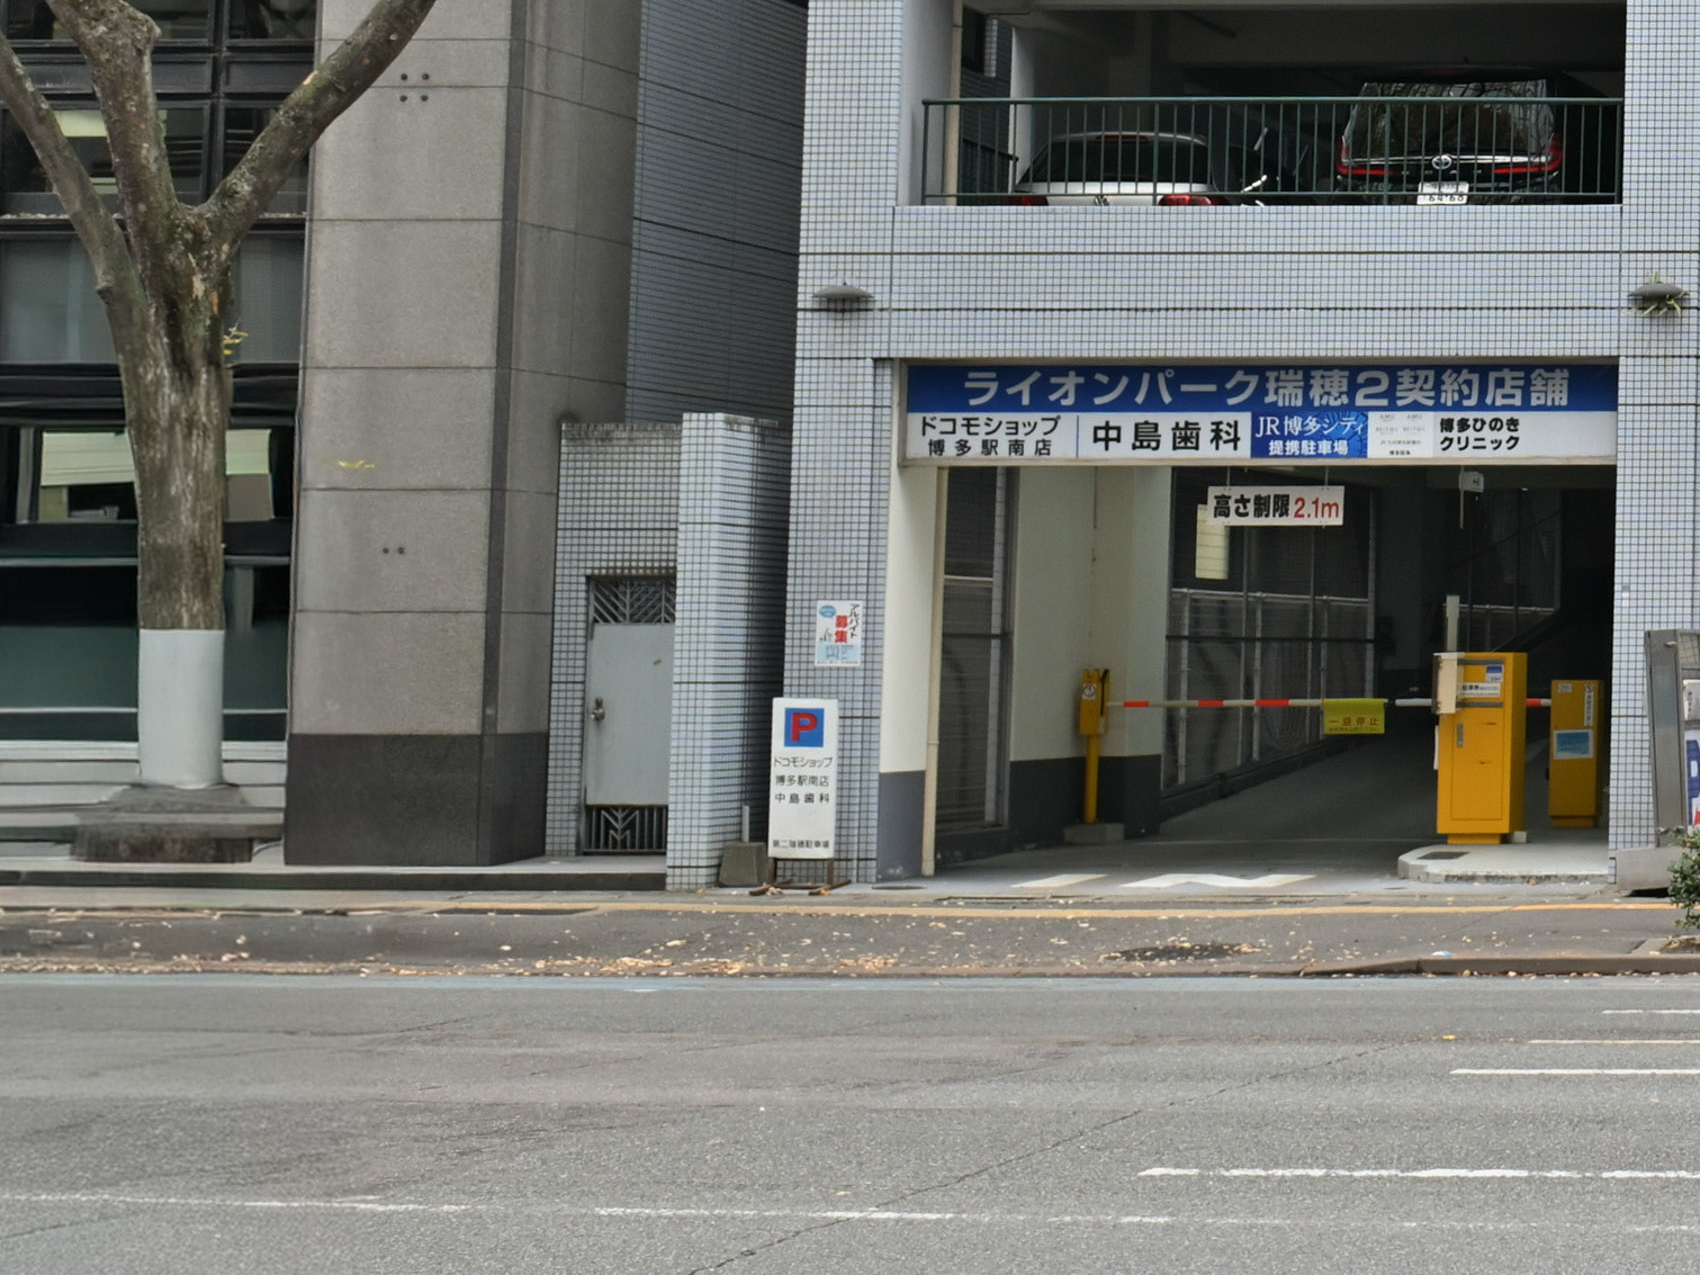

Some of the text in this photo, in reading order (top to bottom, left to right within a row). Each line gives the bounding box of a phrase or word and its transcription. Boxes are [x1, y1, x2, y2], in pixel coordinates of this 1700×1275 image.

[964, 368, 1570, 407] ライオンパーク瑞穂2契約店舗
[921, 414, 1062, 437] ドコモショップ
[1439, 417, 1521, 434] 博多ひのき
[1092, 419, 1241, 452] 中島歯科
[1439, 435, 1521, 452] クリニック
[928, 439, 1052, 457] 博多駅南店
[1268, 439, 1349, 456] 提携駐車場
[849, 602, 860, 639] アルバイト
[791, 712, 818, 742] P
[773, 756, 833, 768] ドコモショップ
[775, 775, 829, 787] 博多駅南店
[775, 793, 830, 804] 中島歯科
